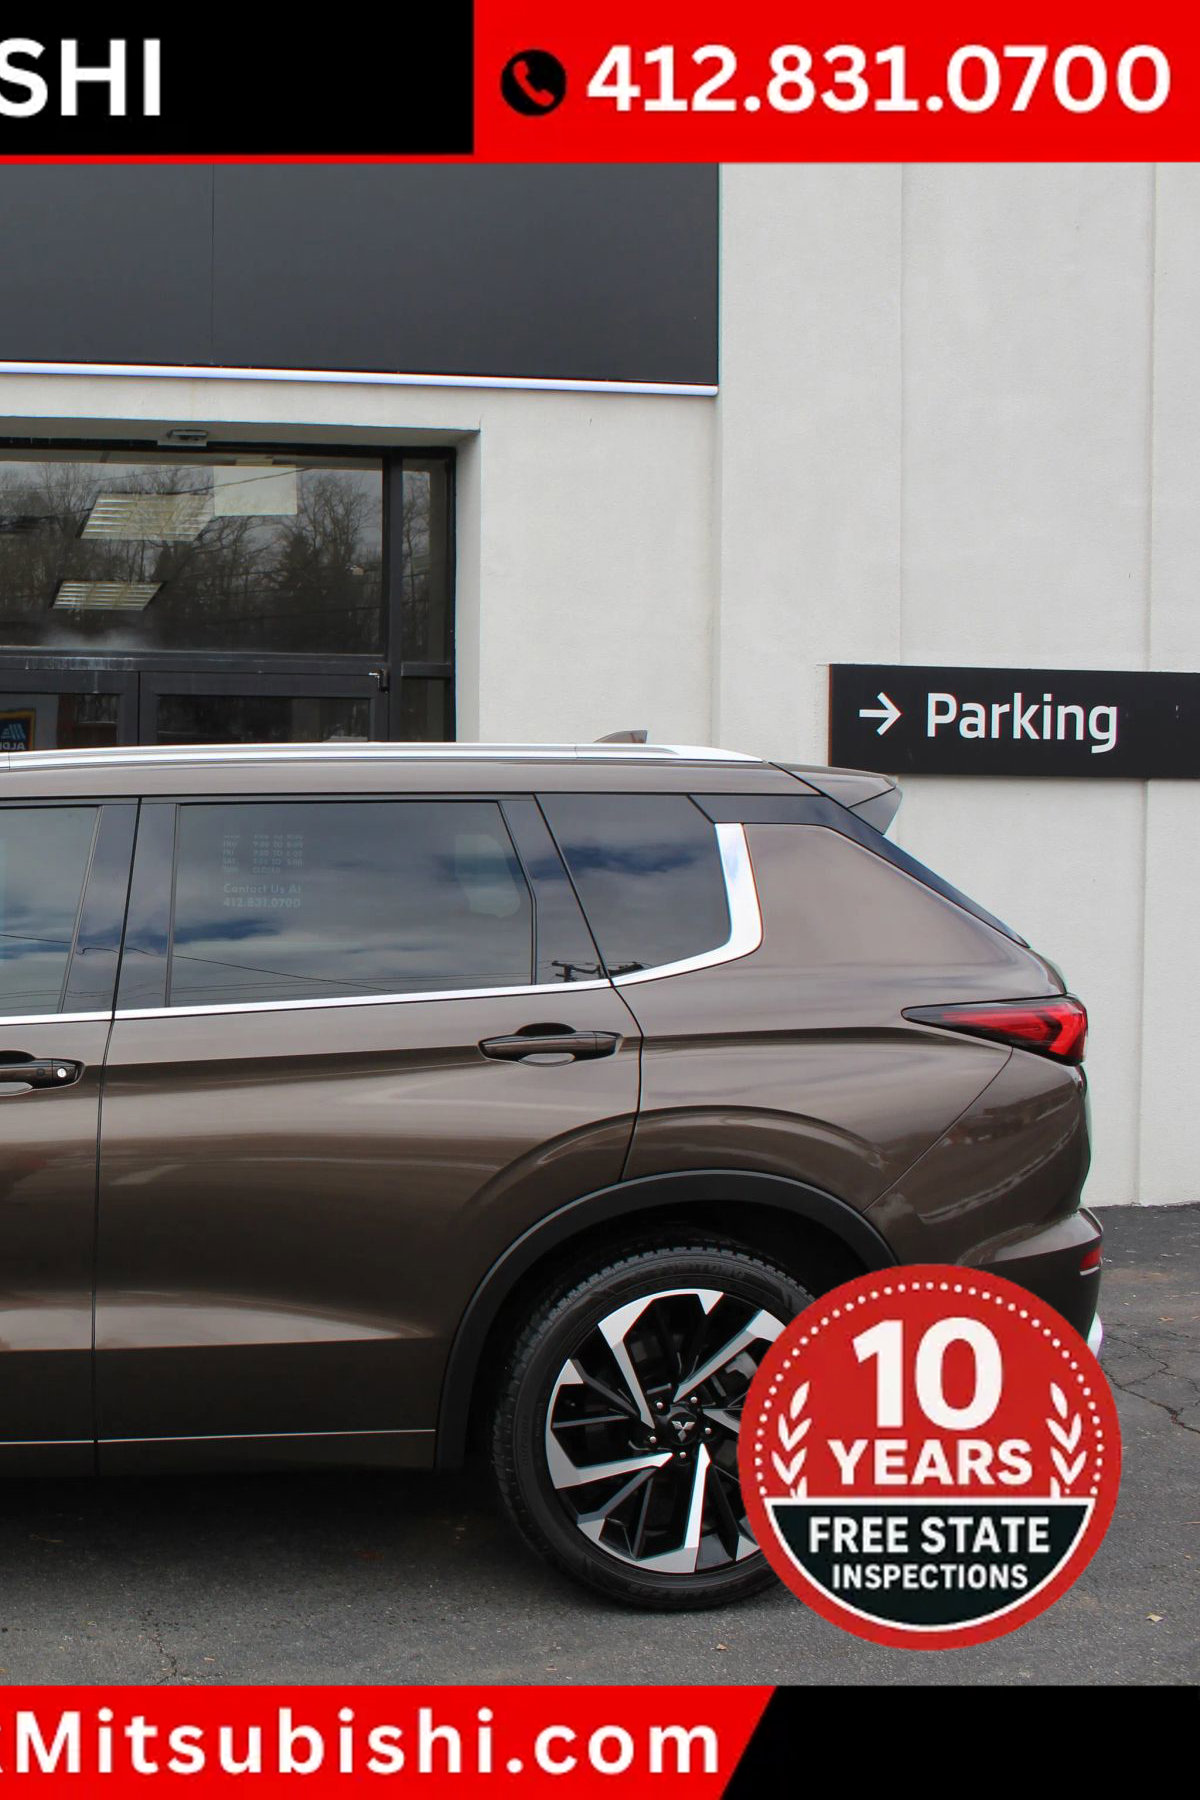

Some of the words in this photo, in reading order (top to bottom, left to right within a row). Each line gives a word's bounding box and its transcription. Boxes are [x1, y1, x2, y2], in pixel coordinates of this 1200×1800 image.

[927, 692, 1117, 754] Parking
[223, 883, 266, 893] Contact
[270, 884, 285, 894] Us
